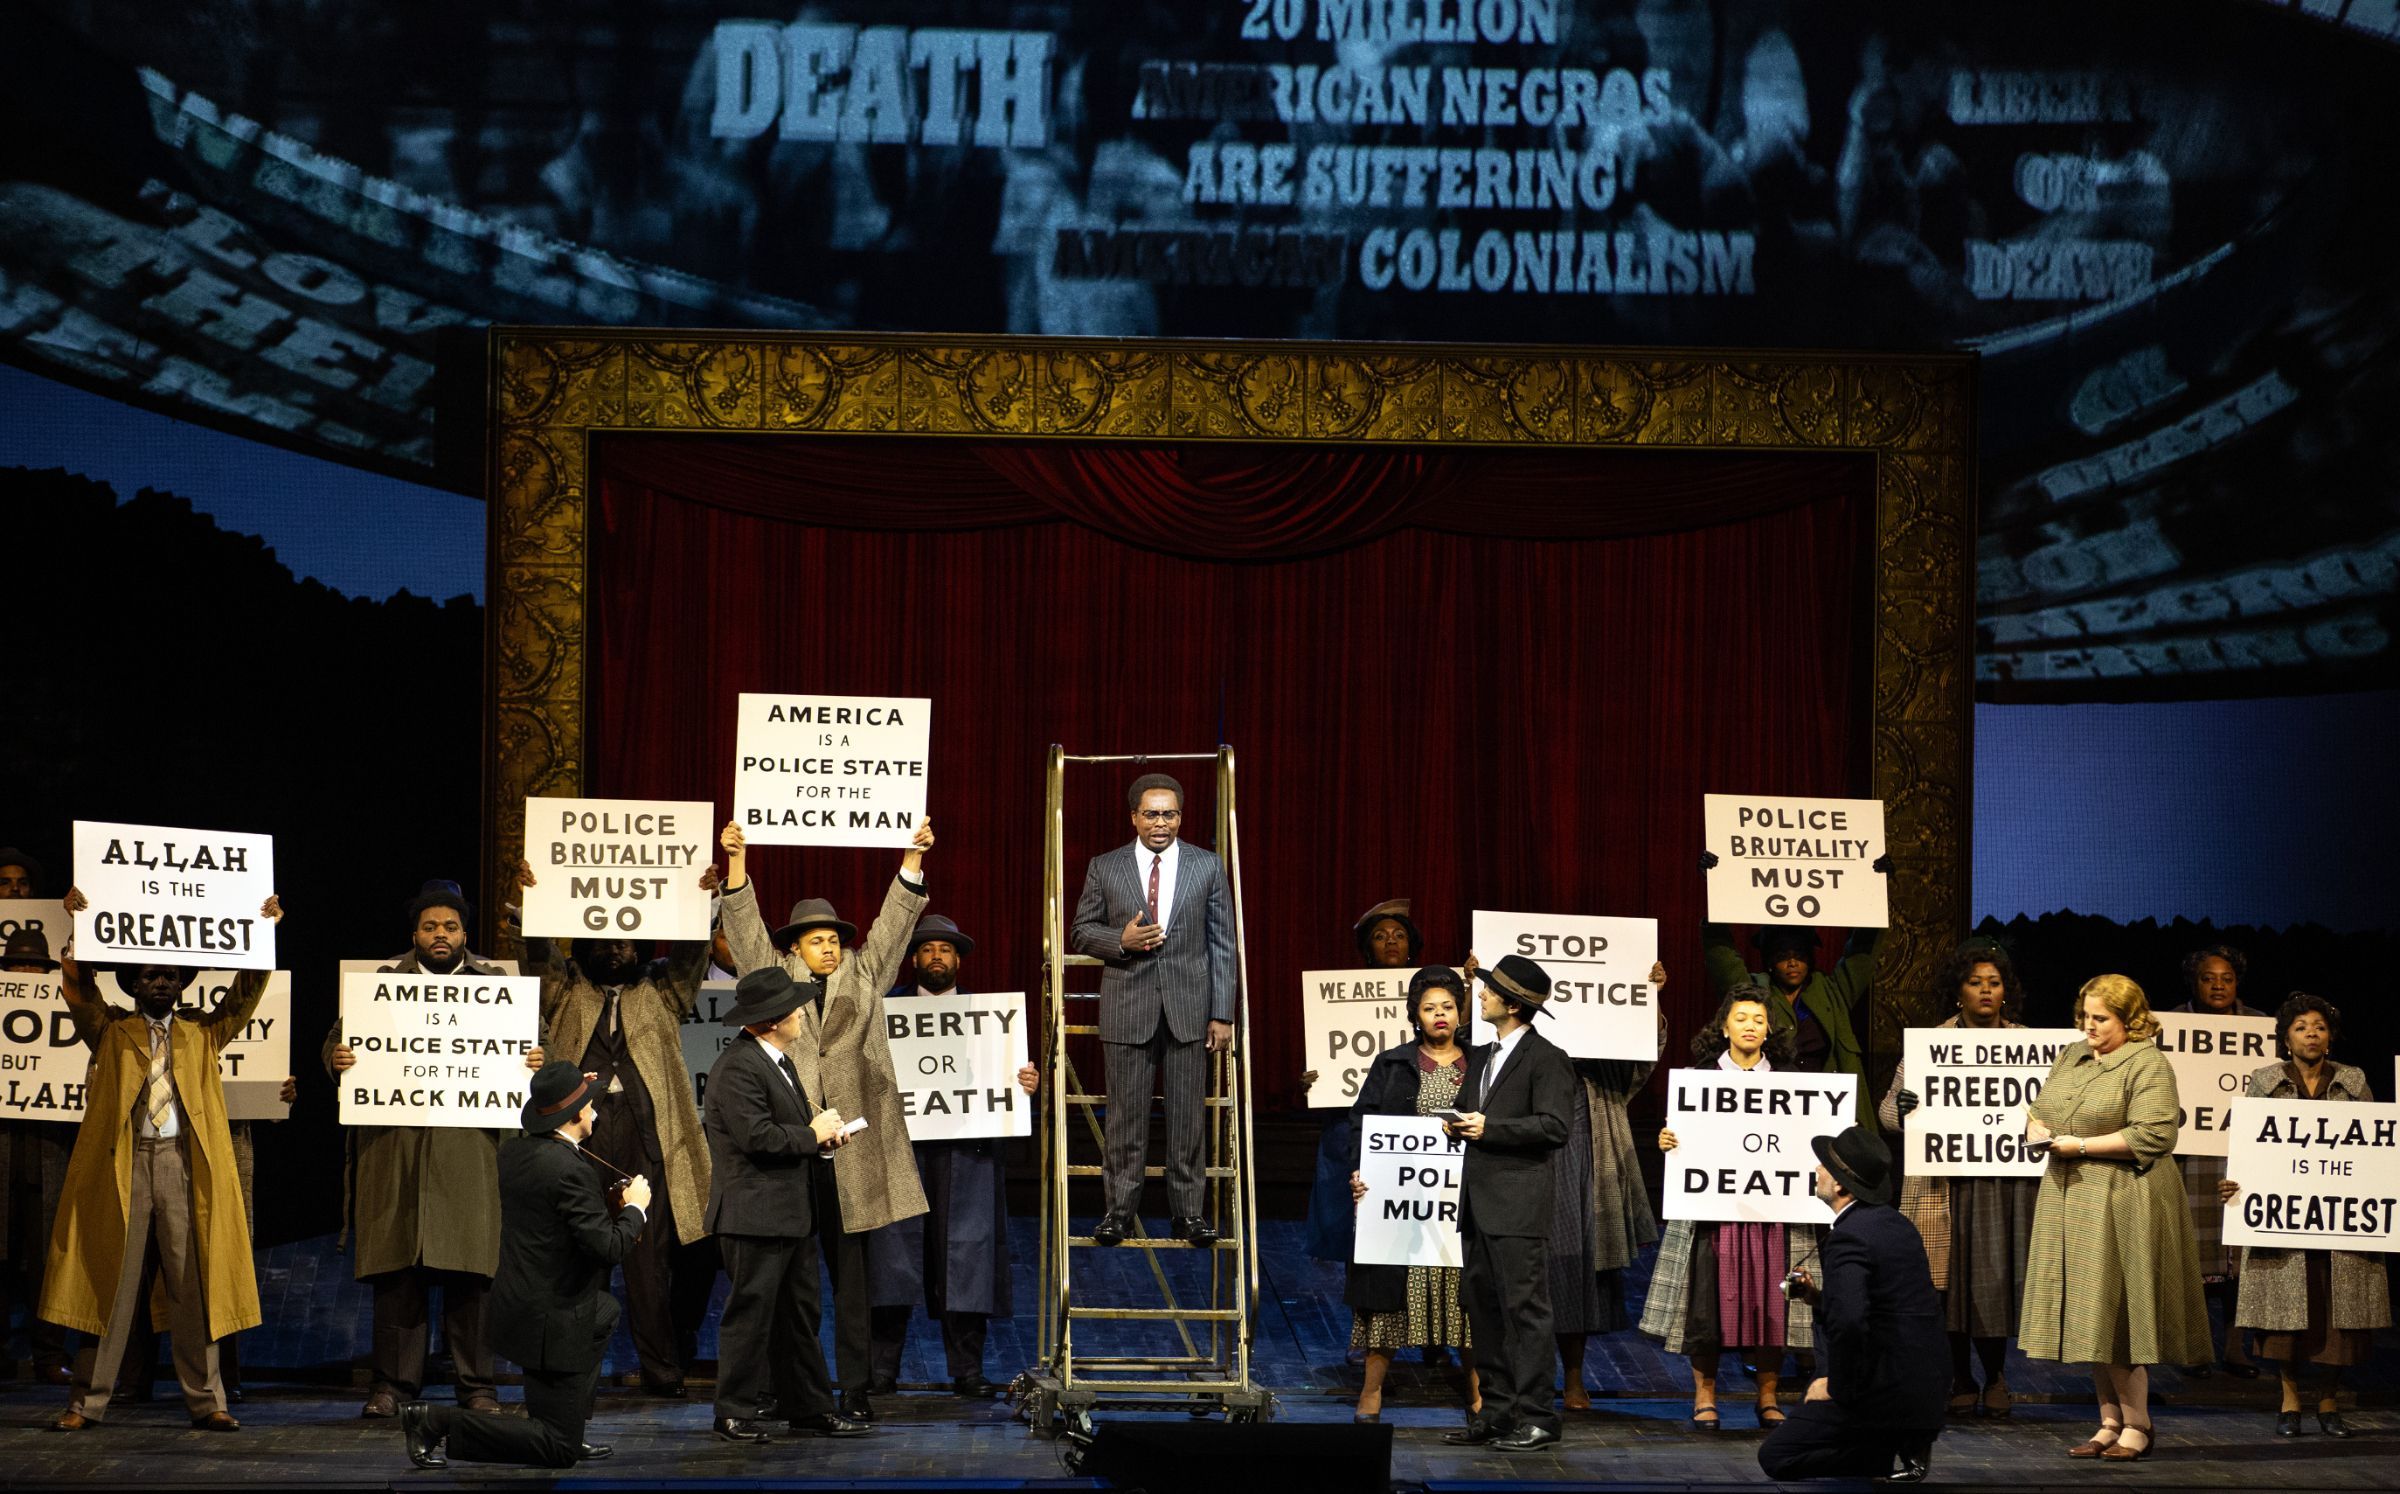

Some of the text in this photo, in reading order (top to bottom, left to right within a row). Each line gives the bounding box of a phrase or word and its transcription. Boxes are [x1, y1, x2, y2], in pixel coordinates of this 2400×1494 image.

[1316, 0, 1558, 45] MILLION
[711, 20, 1053, 148] DEATH
[1183, 143, 1617, 211] ARE SUFFERING
[1358, 228, 1757, 295] COLONIALISM
[768, 704, 904, 726] AMERICA
[819, 734, 850, 747] IS A
[743, 756, 923, 777] POLICE STATE
[796, 785, 872, 800] FOR THE
[562, 811, 676, 835] POLICE
[747, 808, 912, 829] BLACK MAN
[1739, 807, 1848, 830] POLICE
[101, 838, 248, 873] ALLAH
[551, 841, 698, 866] BRUTALITY
[1730, 835, 1869, 858] BRUTALITY
[141, 880, 206, 898] IS THE
[570, 877, 668, 899] MUST
[1751, 868, 1844, 889] MUST
[1765, 894, 1821, 918] GO
[583, 905, 642, 931] GO
[94, 911, 254, 951] GREATEST
[1517, 933, 1608, 957] STOP
[34, 984, 50, 999] IS
[374, 983, 513, 1005] AMERICA
[1320, 982, 1346, 1000] WE
[1353, 981, 1386, 999] ARE
[1554, 980, 1647, 1006] STICE
[425, 1013, 458, 1025] IS A
[1376, 1006, 1397, 1019] IN
[887, 1009, 1017, 1039] BERTY
[349, 1036, 533, 1055] POLICE STATE
[1930, 1044, 1963, 1064] WE
[2, 1055, 41, 1071] BUT
[403, 1065, 480, 1079] FOR THE
[918, 1055, 957, 1075] OR
[0, 1080, 86, 1112] LAH
[354, 1088, 523, 1109] BLACK MAN
[1678, 1087, 1849, 1116] LIBERTY
[1925, 1076, 2045, 1107] FREEDO
[1982, 1113, 2005, 1125] OF
[1369, 1133, 1437, 1151] STOP
[1743, 1133, 1781, 1153] OR
[2256, 1116, 2397, 1149] ALLAH
[1399, 1167, 1458, 1188] POL
[2292, 1159, 2353, 1176] IS THE
[1384, 1200, 1457, 1222] MUR
[2243, 1193, 2397, 1234] GREATEST
